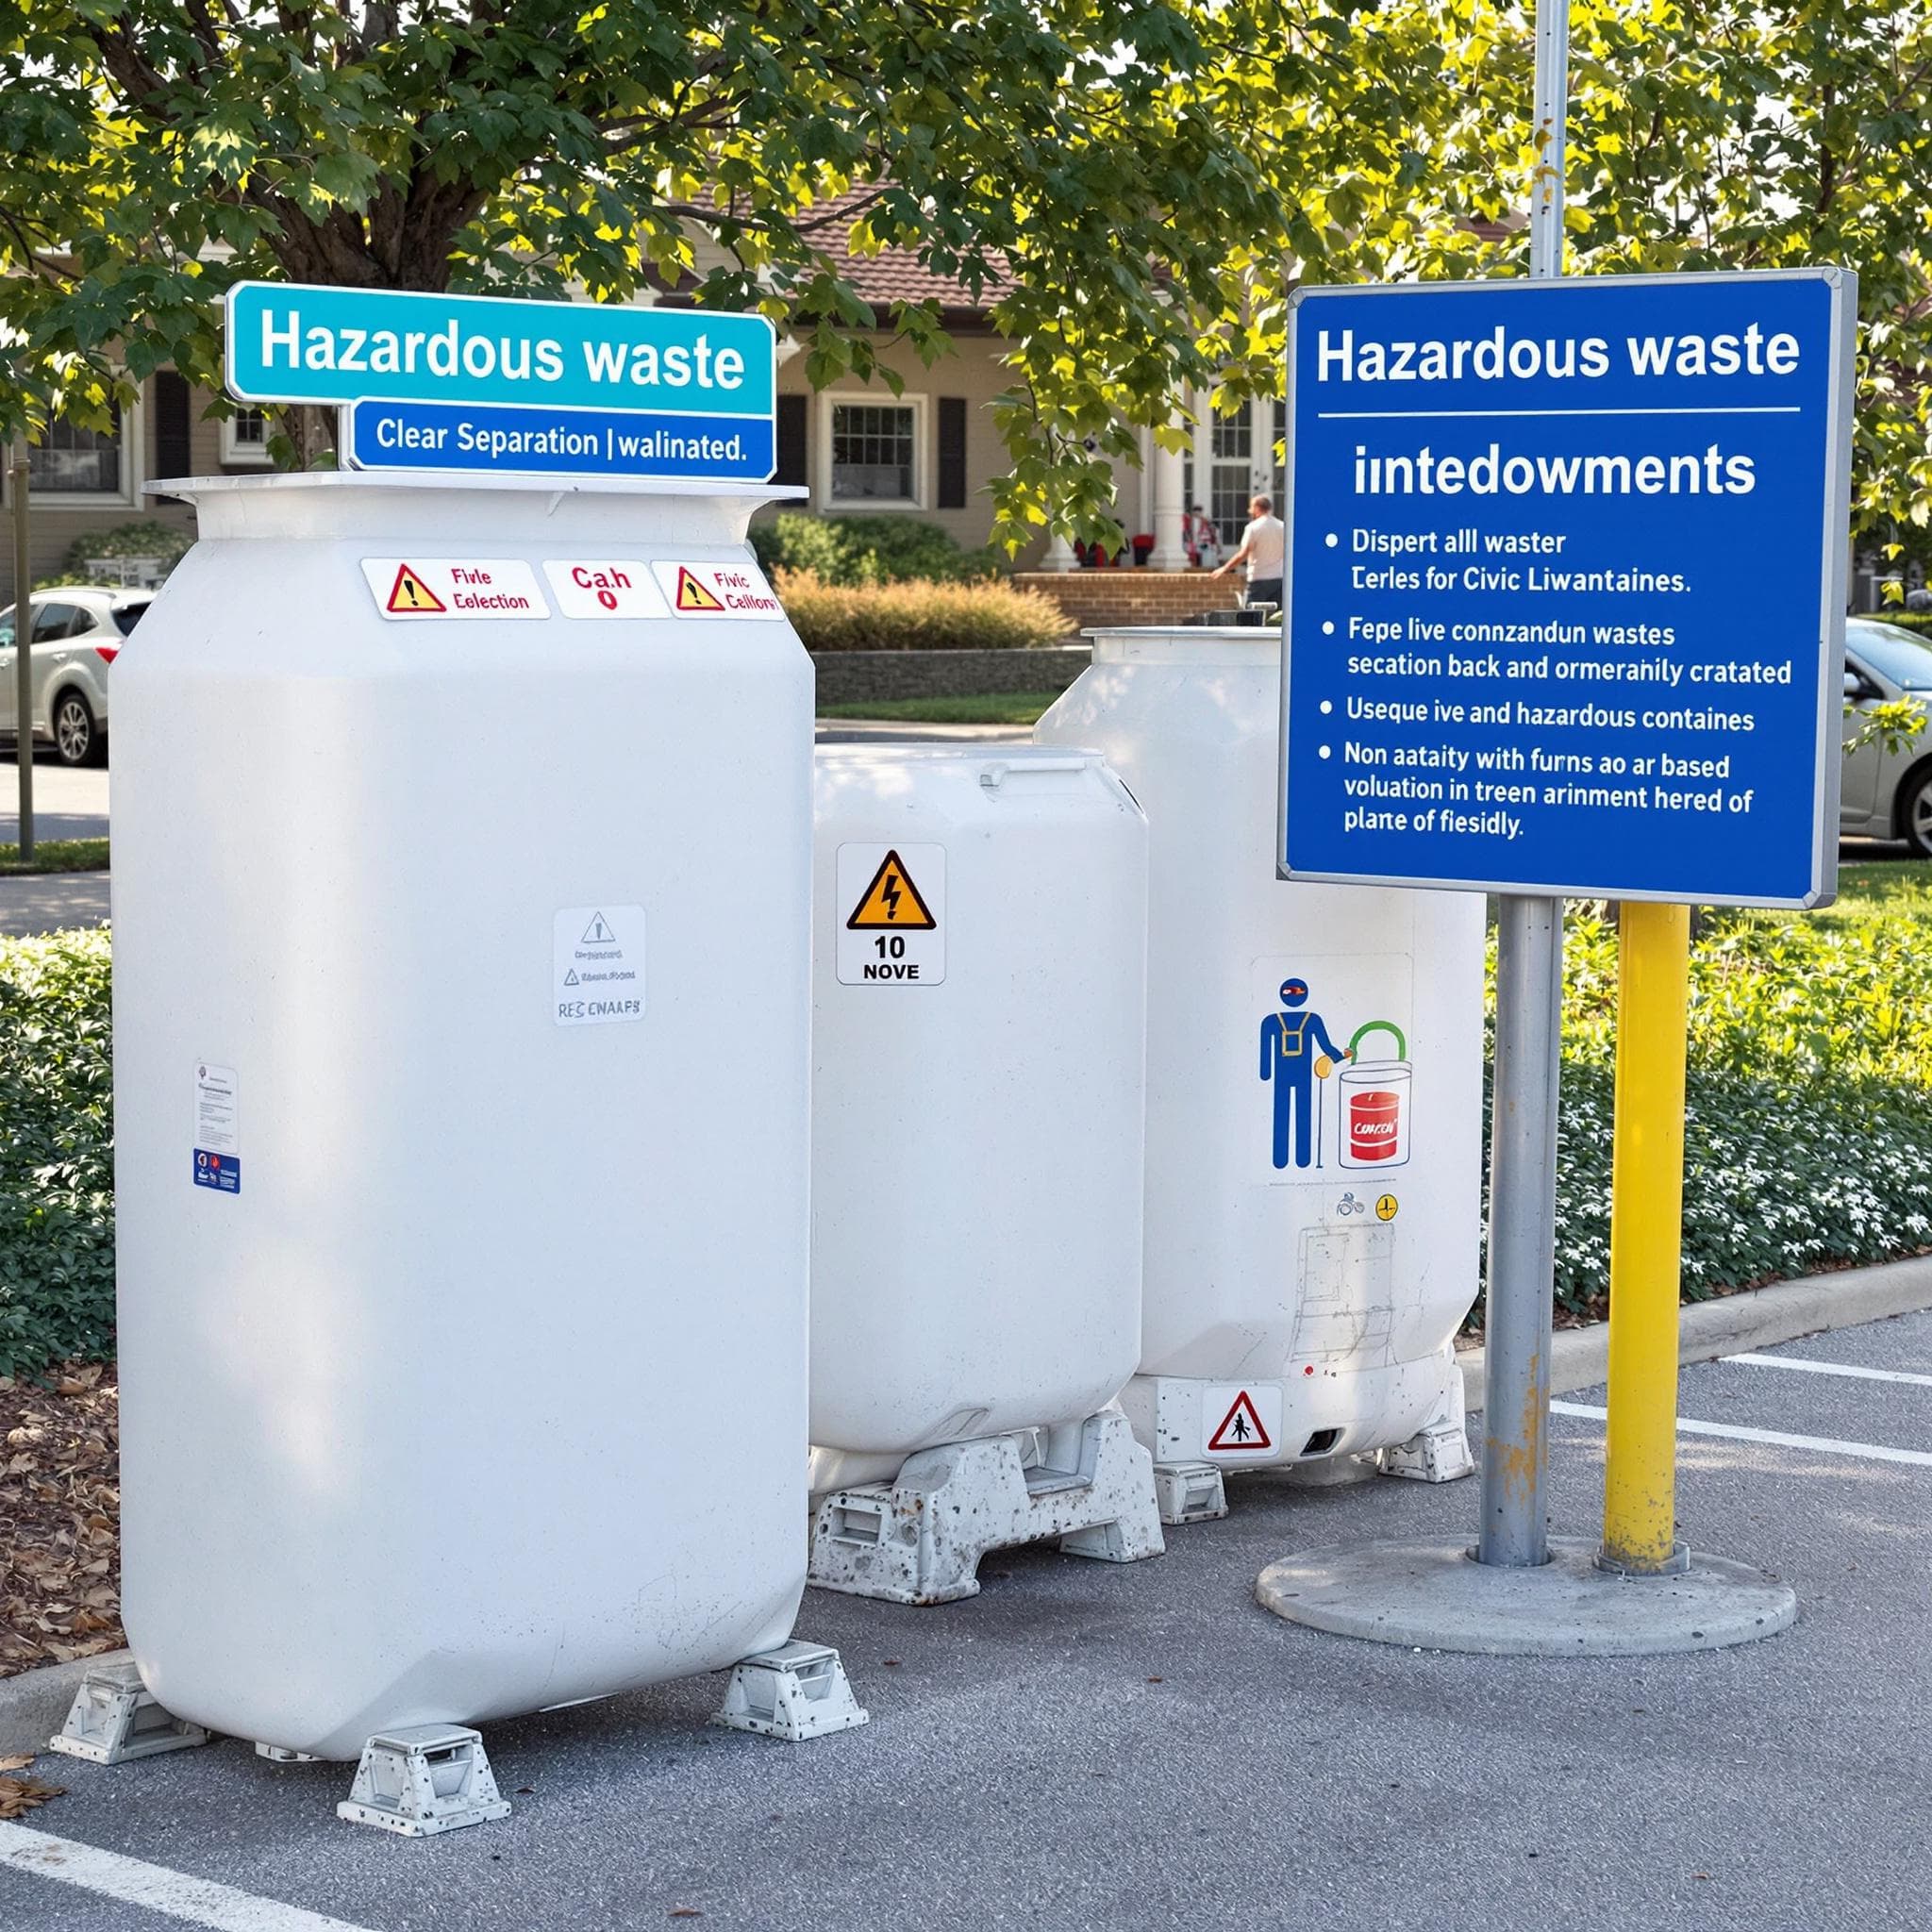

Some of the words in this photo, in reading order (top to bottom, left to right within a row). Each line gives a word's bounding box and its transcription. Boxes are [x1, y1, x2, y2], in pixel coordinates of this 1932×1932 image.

[261, 308, 564, 382] Hazardous
[582, 334, 744, 390] waste
[1318, 325, 1609, 382] Hazardous
[1626, 322, 1800, 376] waste
[376, 418, 448, 449] Clear
[457, 422, 598, 458] Separation
[1353, 528, 1438, 558] Dispert
[1484, 532, 1567, 554] waster
[1425, 565, 1458, 591] for
[1463, 566, 1521, 591] Civic
[1528, 567, 1691, 592] Liwantaines.
[1349, 616, 1403, 644] Fepe
[1408, 617, 1446, 641] live
[1452, 620, 1586, 644] connzandun
[1592, 624, 1675, 645] wastes
[1348, 652, 1441, 675] secation
[1448, 653, 1501, 677] back
[1507, 655, 1548, 679] and
[1690, 659, 1791, 685] cratated
[1347, 696, 1428, 724] Useque
[1434, 699, 1465, 723] ive
[1469, 701, 1510, 724] and
[1517, 701, 1636, 728] hazardous
[1641, 707, 1755, 731] containes
[1344, 741, 1388, 765] Non
[1475, 746, 1524, 771] with
[1598, 756, 1626, 774] ao
[1632, 758, 1657, 775] ar
[1661, 753, 1730, 778] based
[1343, 774, 1443, 800] voluation
[1449, 777, 1469, 801] in
[1474, 781, 1536, 804] treen
[1543, 782, 1648, 808] arinment
[1655, 786, 1723, 812] hered
[1728, 789, 1755, 813] of
[1413, 808, 1437, 832] of
[874, 936, 906, 958] 10
[864, 964, 920, 979] NOVE
